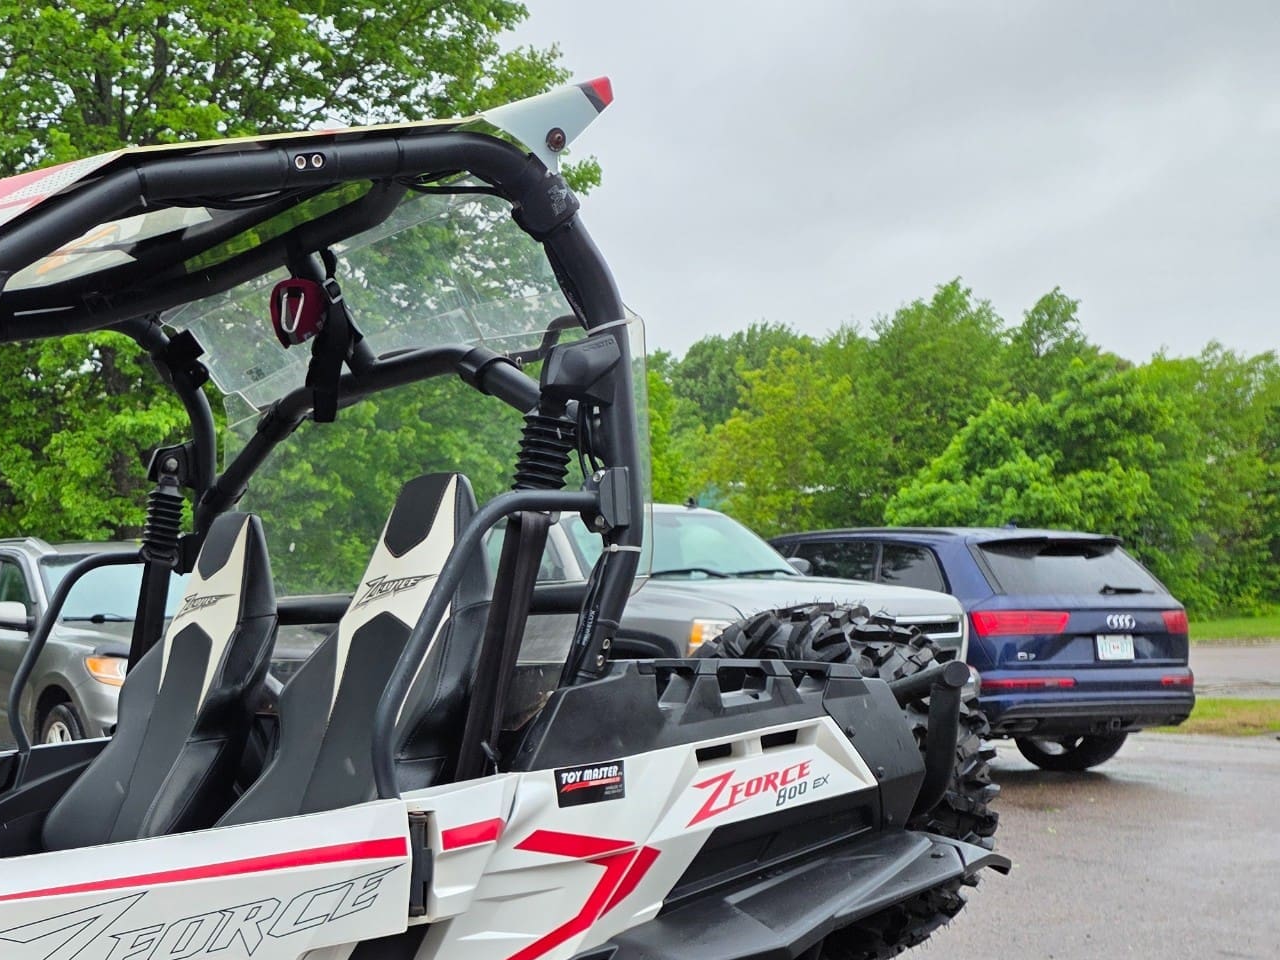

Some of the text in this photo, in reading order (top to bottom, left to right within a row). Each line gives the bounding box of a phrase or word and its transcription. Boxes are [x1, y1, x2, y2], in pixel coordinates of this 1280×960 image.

[561, 765, 619, 784] TOY MASTER
[813, 773, 831, 789] EX
[685, 759, 813, 829] ZFORCE
